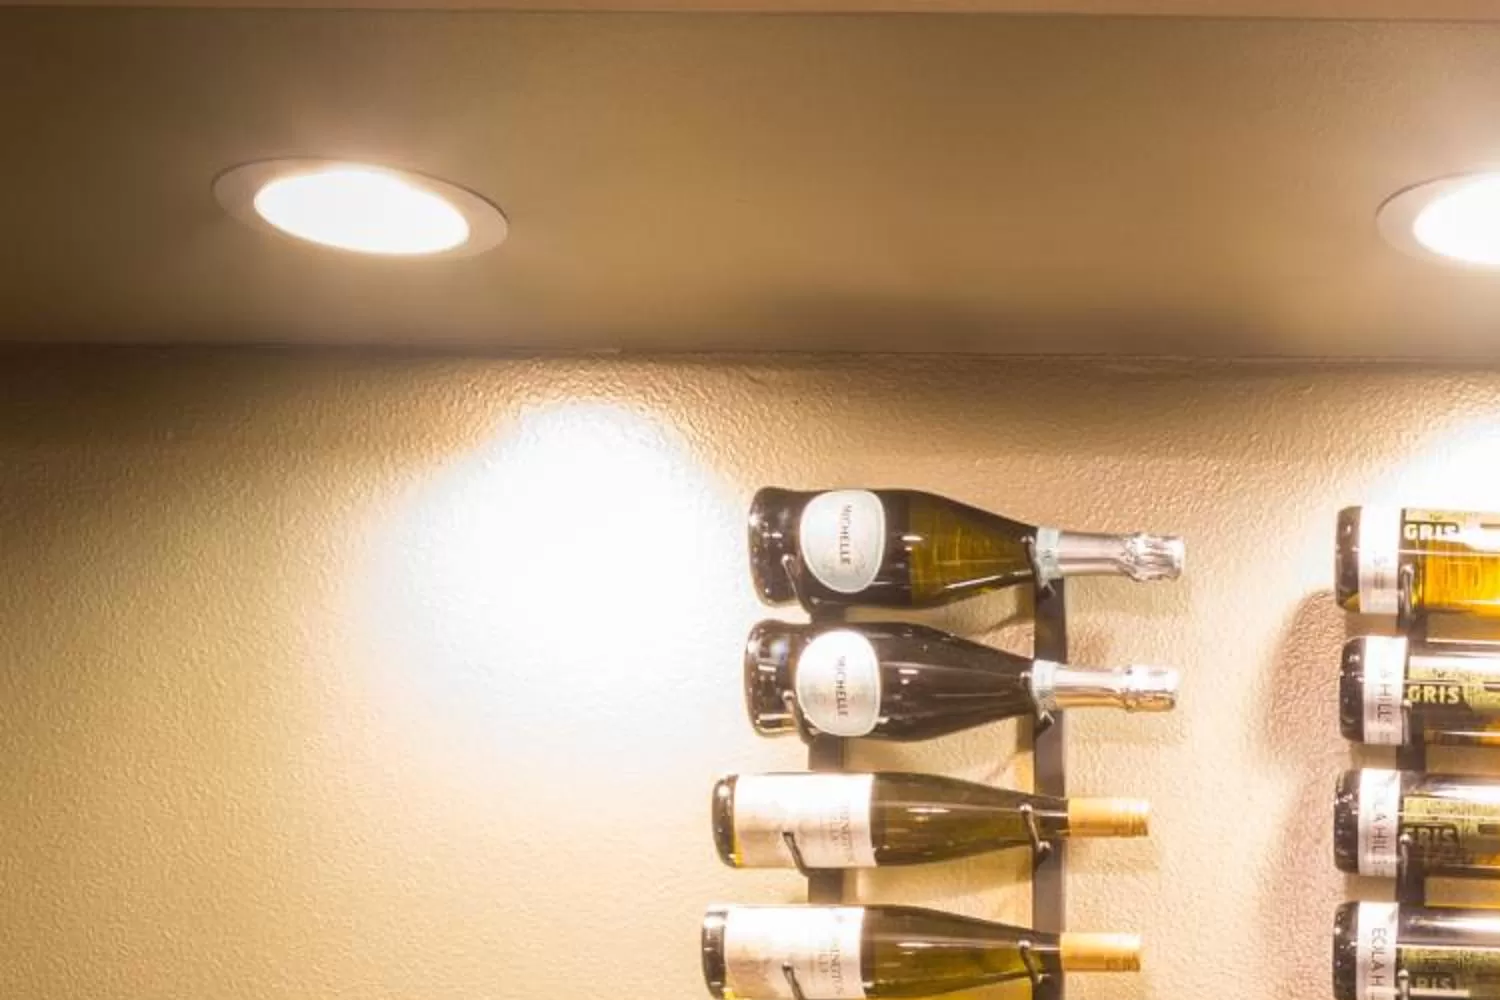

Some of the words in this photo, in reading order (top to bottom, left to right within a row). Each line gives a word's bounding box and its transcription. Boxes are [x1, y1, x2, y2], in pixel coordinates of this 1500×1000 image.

[839, 504, 854, 565] MICHELLE
[1403, 523, 1460, 541] GRIS
[836, 656, 849, 718] MICHELLE
[1407, 685, 1460, 704] GRIS
